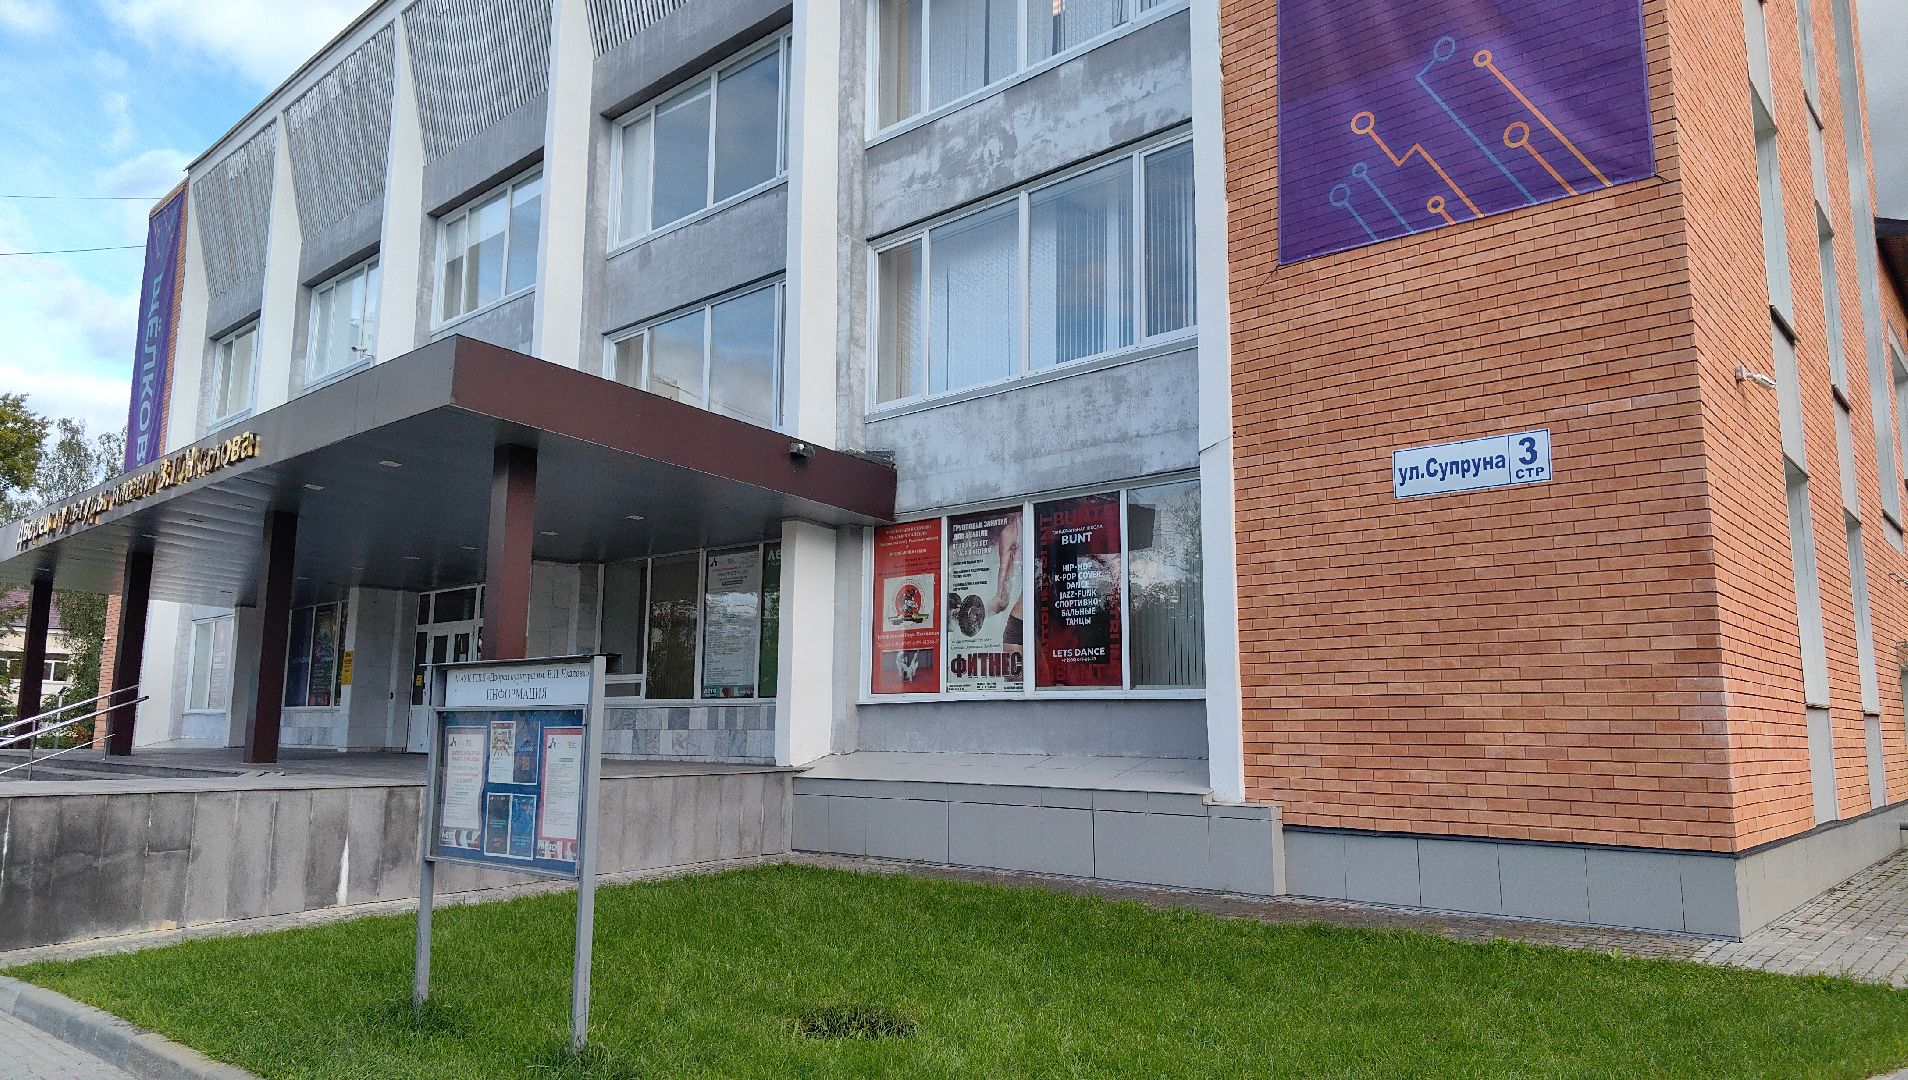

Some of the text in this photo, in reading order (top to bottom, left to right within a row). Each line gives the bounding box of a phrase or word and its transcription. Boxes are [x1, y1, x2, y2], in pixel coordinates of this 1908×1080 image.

[1518, 436, 1538, 465] 3
[1515, 466, 1545, 479] СТР
[1061, 531, 1093, 546] BUNT
[1062, 562, 1093, 572] HIP-HOP
[1054, 570, 1101, 582] K-POP COVER
[1066, 580, 1090, 590] DANCE
[1059, 589, 1097, 600] JAZZ-FUNK
[1054, 598, 1102, 609] СПОРТИВНО-
[1061, 607, 1096, 617] БАЛЬНЫЕ
[1065, 616, 1091, 626] ТАНЦЫ
[1052, 647, 1106, 658] LETS DANCE
[951, 651, 1022, 678] ФИТНЕС
[486, 687, 548, 701] ИНФОРМАЦИЯ
